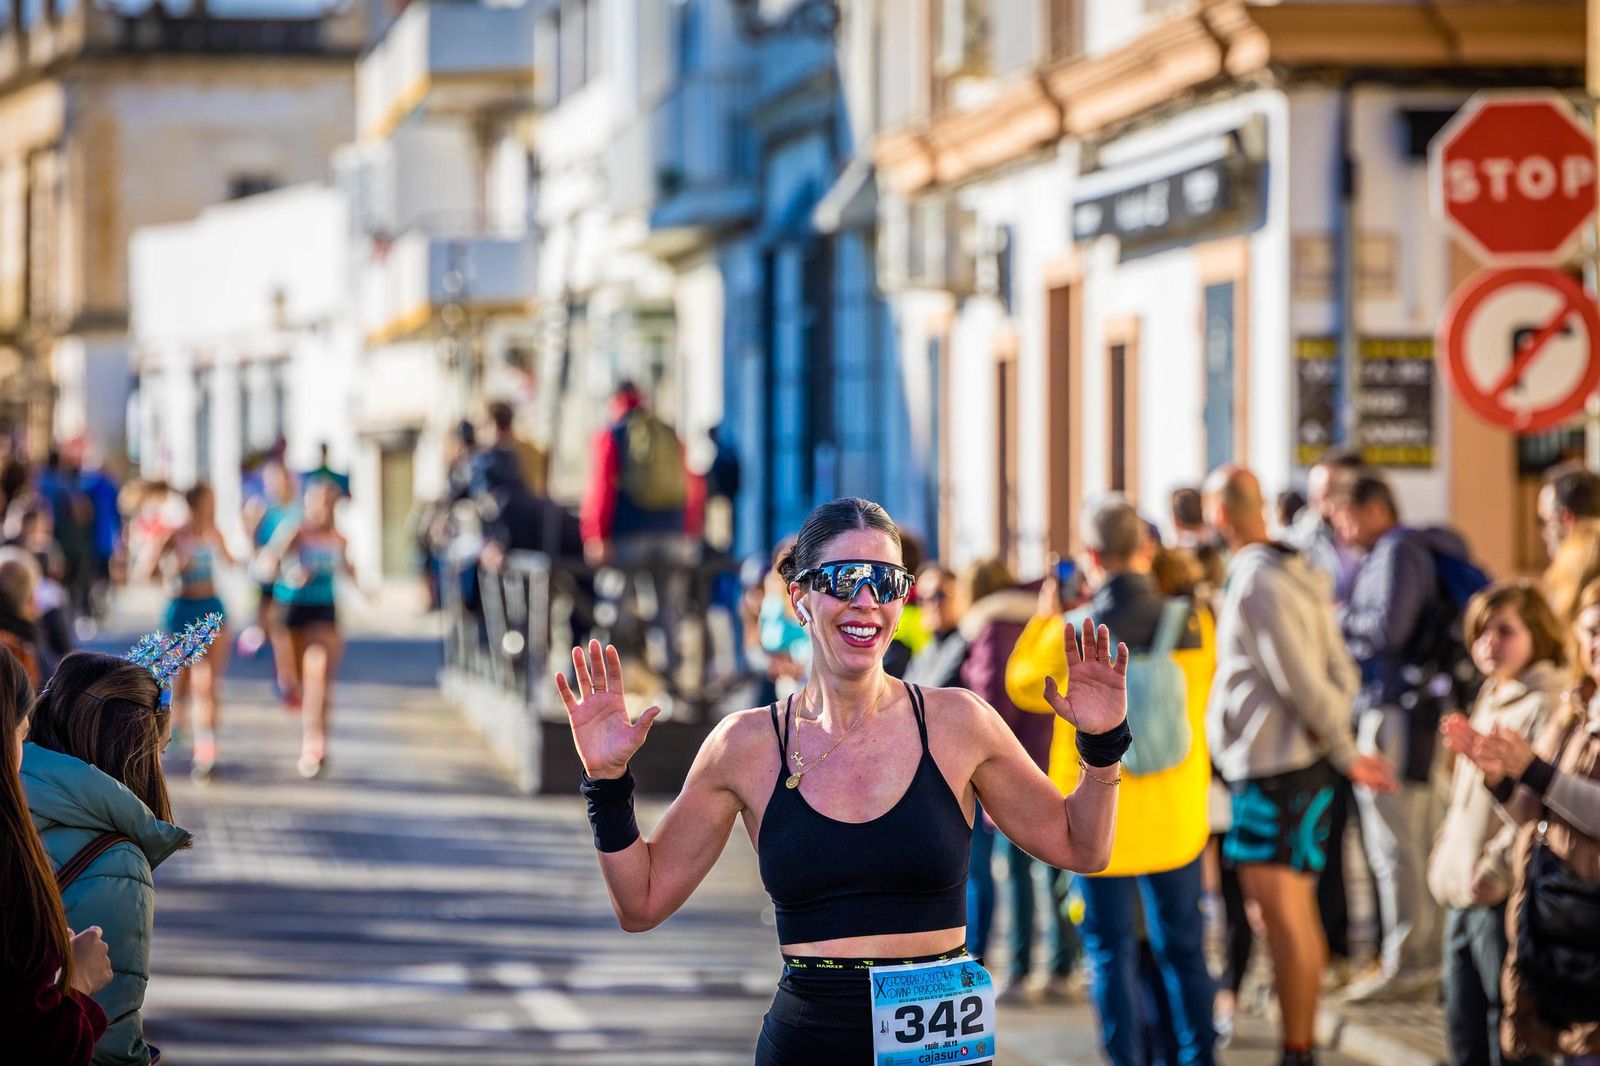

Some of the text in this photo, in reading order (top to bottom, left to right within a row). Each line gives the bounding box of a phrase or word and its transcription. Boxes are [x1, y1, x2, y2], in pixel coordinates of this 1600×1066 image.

[1447, 155, 1593, 203] STOP
[895, 996, 984, 1044] 342
[919, 1049, 959, 1064] cajasur
